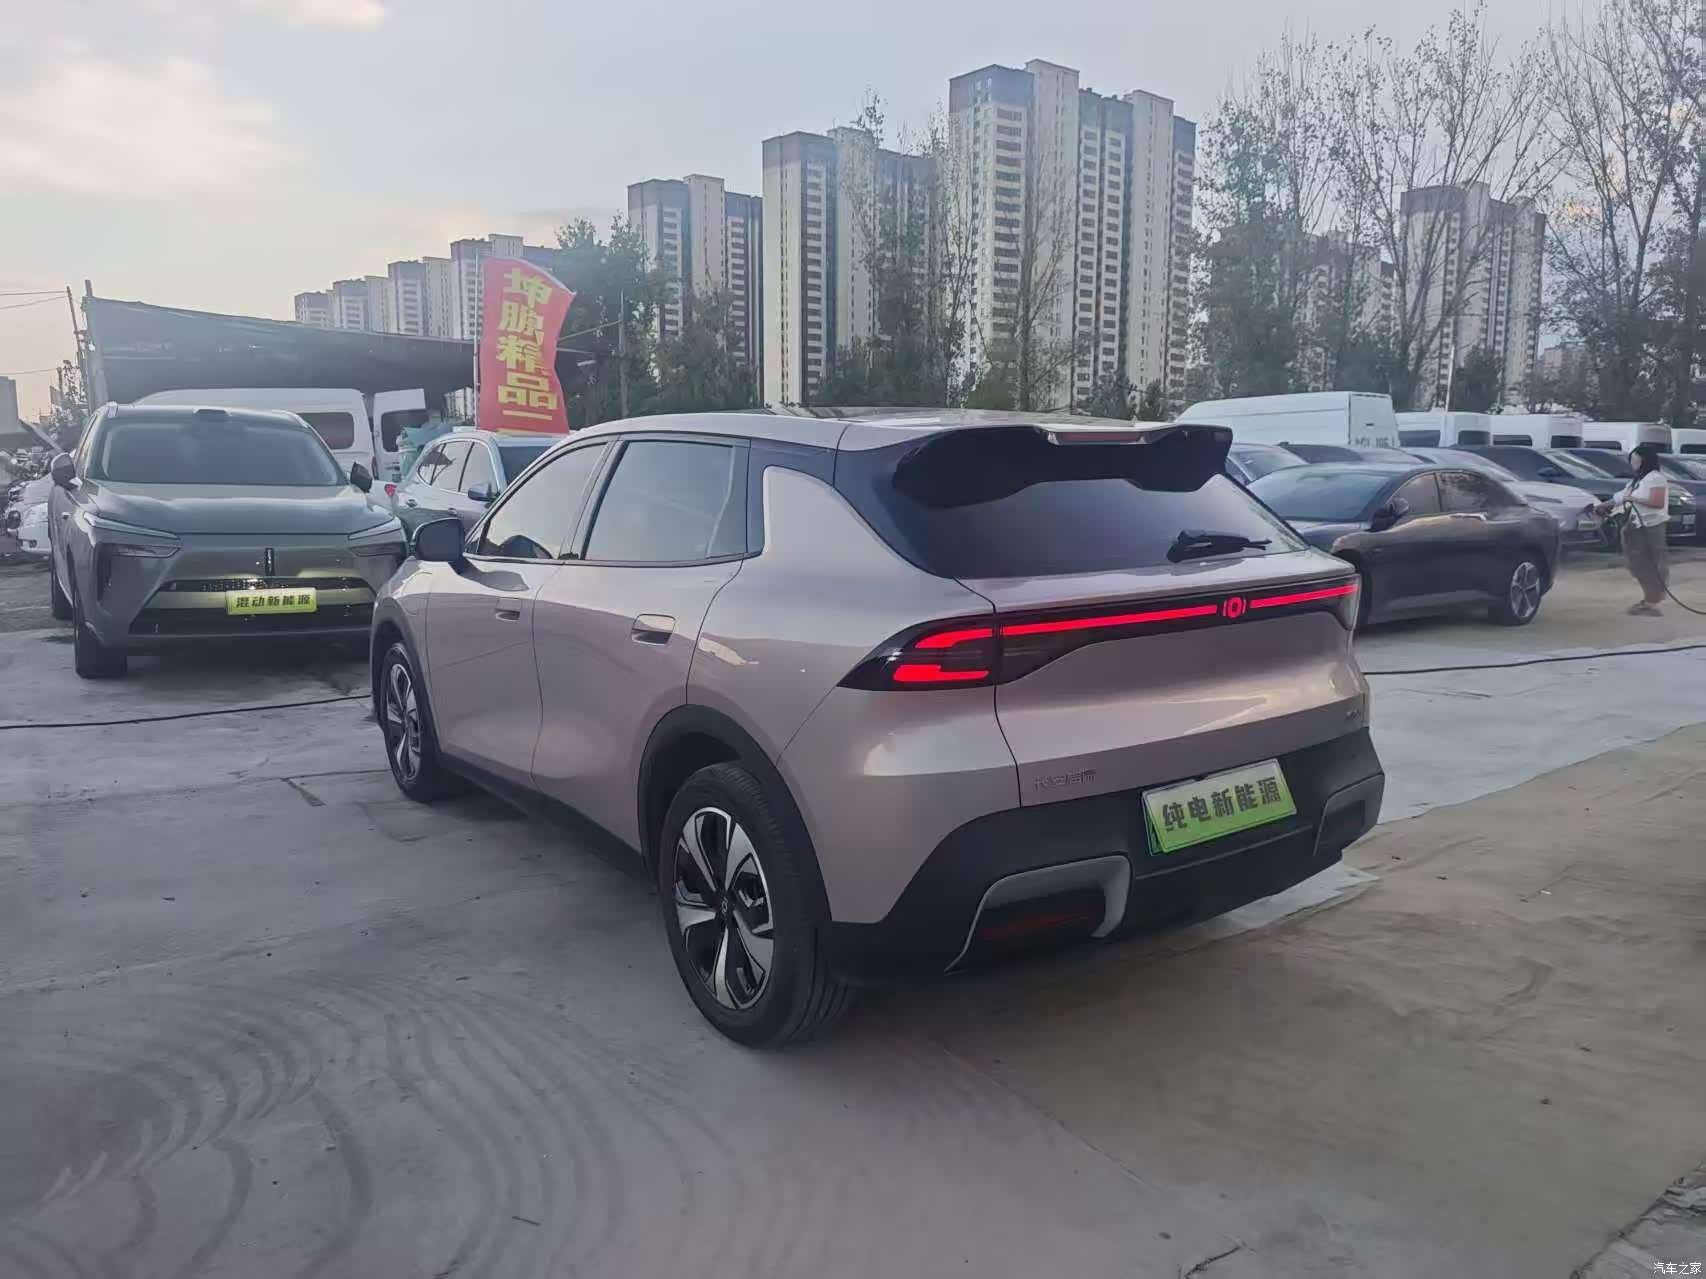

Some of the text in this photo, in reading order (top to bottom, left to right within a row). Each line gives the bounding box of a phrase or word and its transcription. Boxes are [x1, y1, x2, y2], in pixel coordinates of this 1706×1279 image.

[1162, 776, 1281, 832] 纯电新能源
